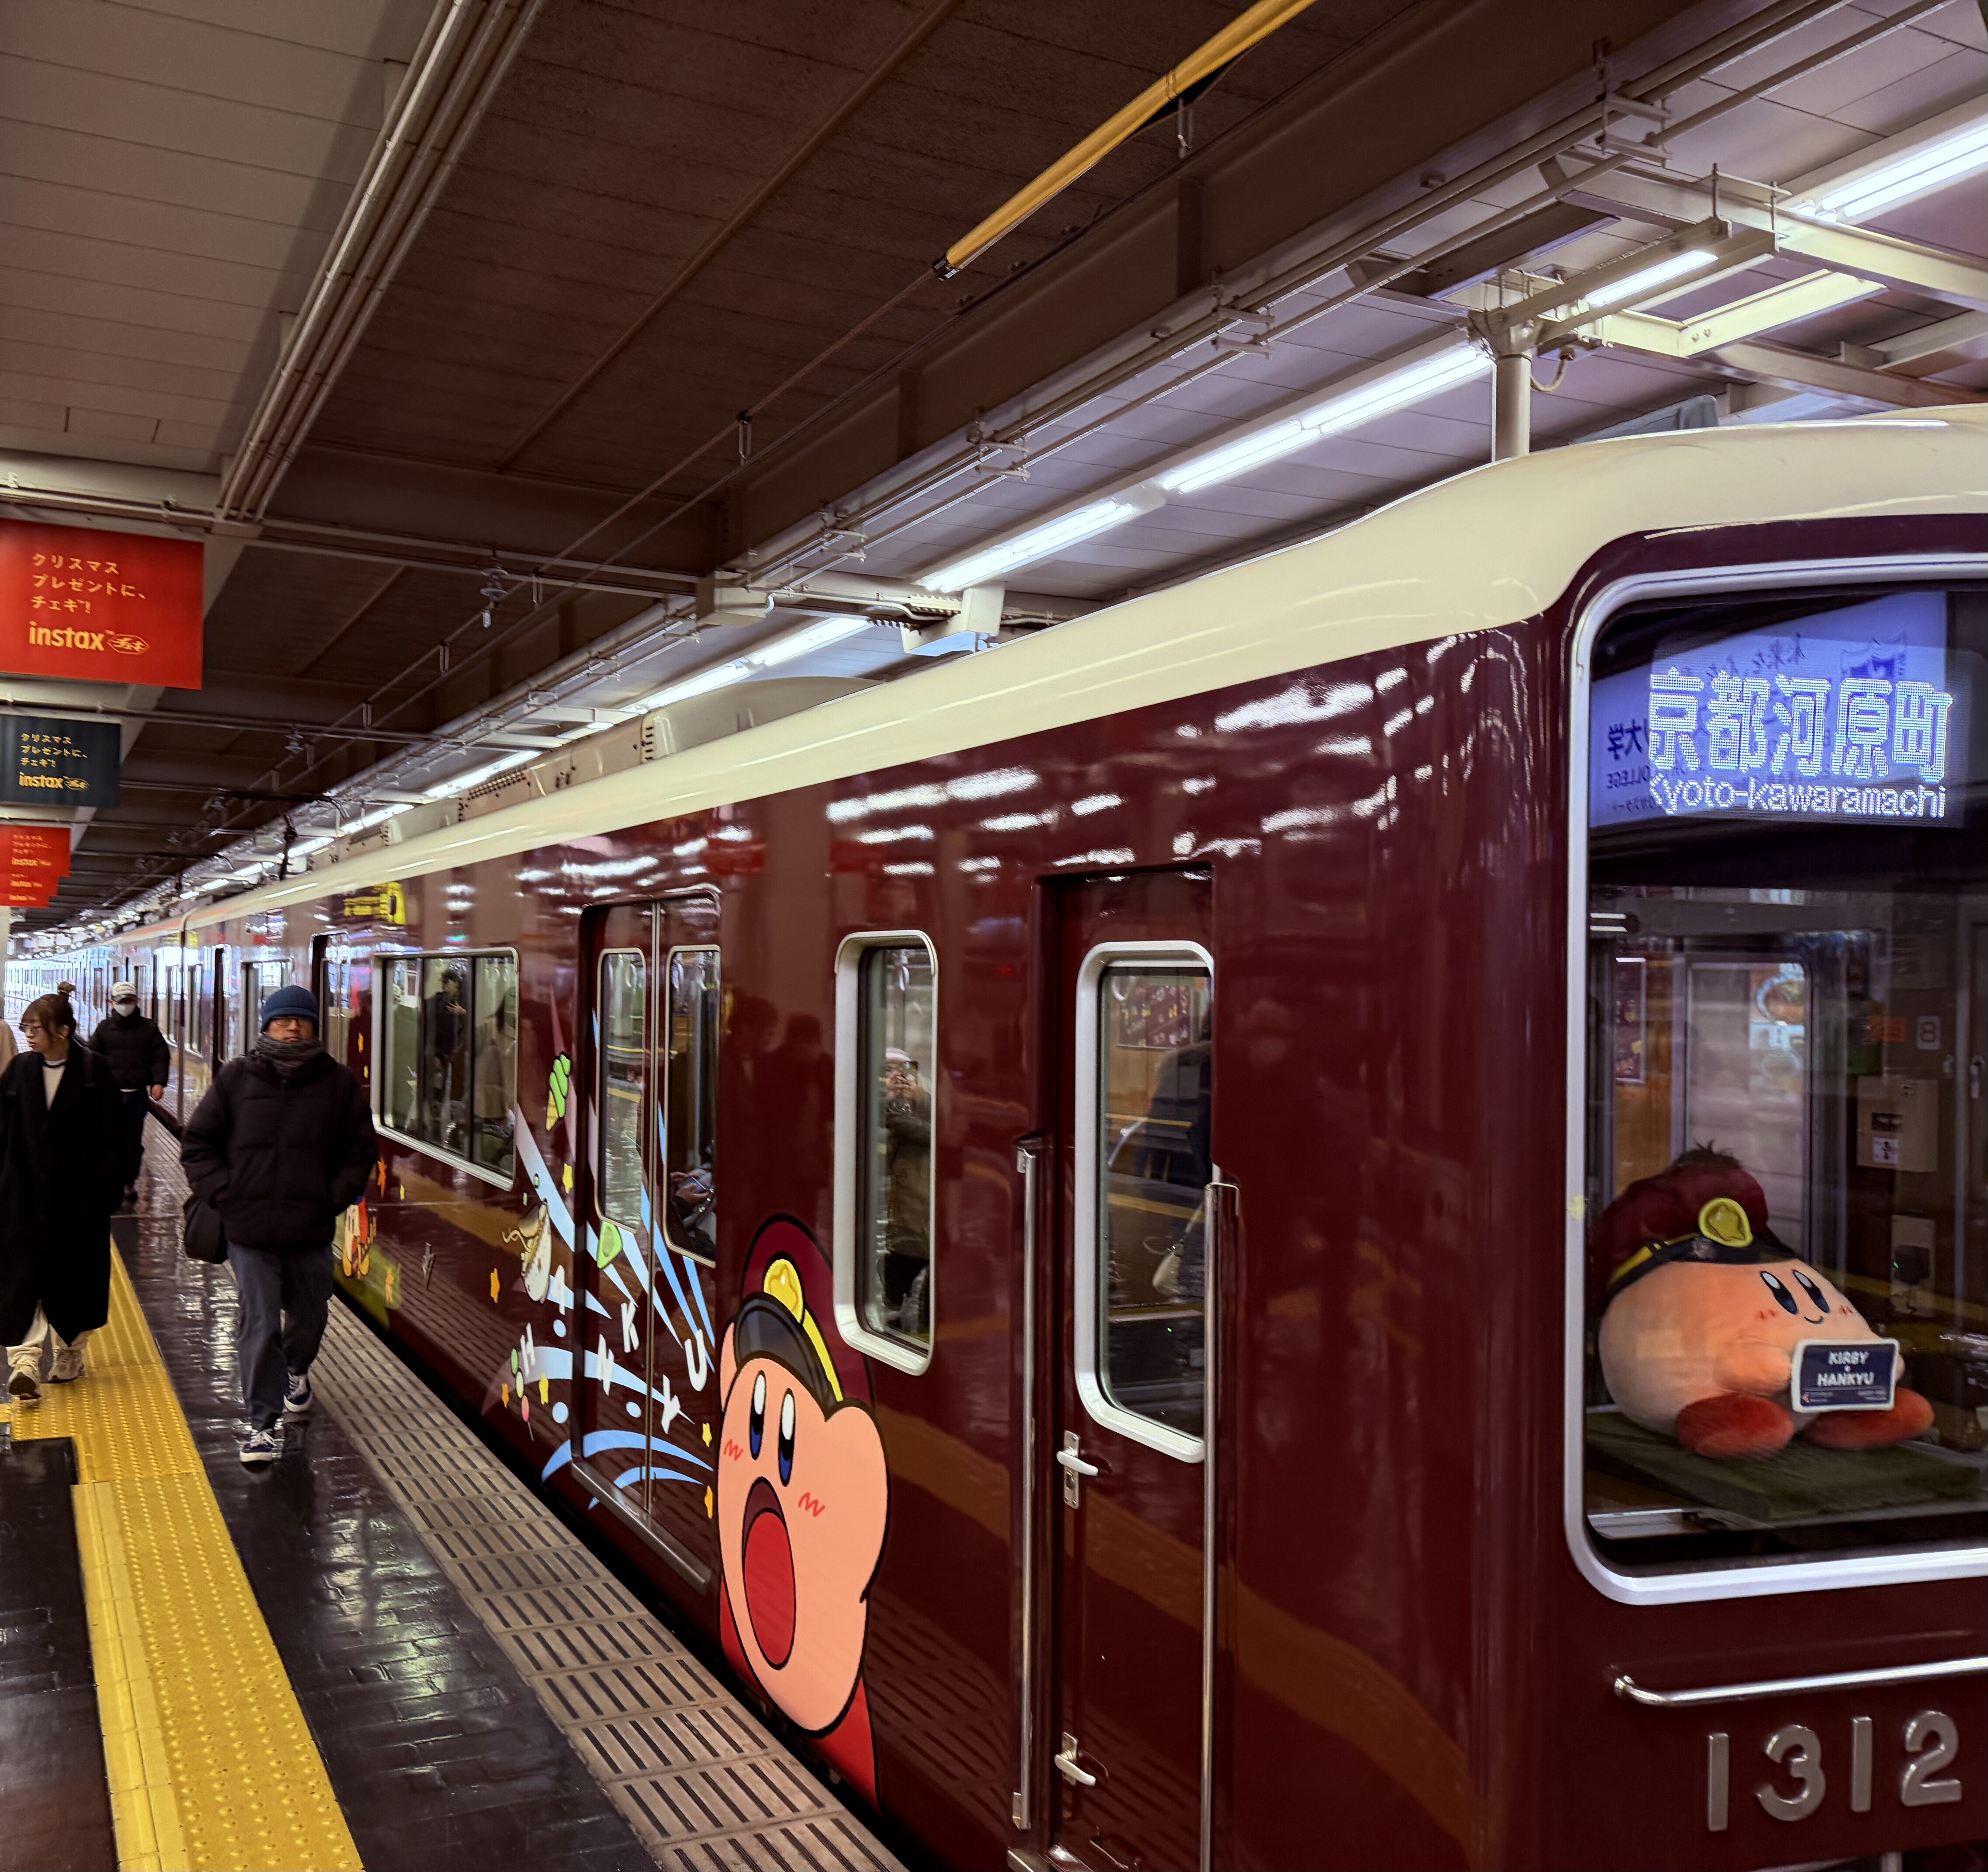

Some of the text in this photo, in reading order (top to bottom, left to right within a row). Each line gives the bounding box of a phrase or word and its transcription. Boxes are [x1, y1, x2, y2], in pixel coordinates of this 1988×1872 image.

[31, 552, 119, 574] クリスマス
[31, 574, 146, 600] プレゼントに、
[29, 621, 105, 651] instax
[1649, 667, 1953, 785] 京都河原町
[19, 772, 64, 789] instax
[1828, 1351, 1870, 1365] KIRBY
[1817, 1372, 1875, 1386] HANKYU
[1708, 1710, 1962, 1832] 1312
